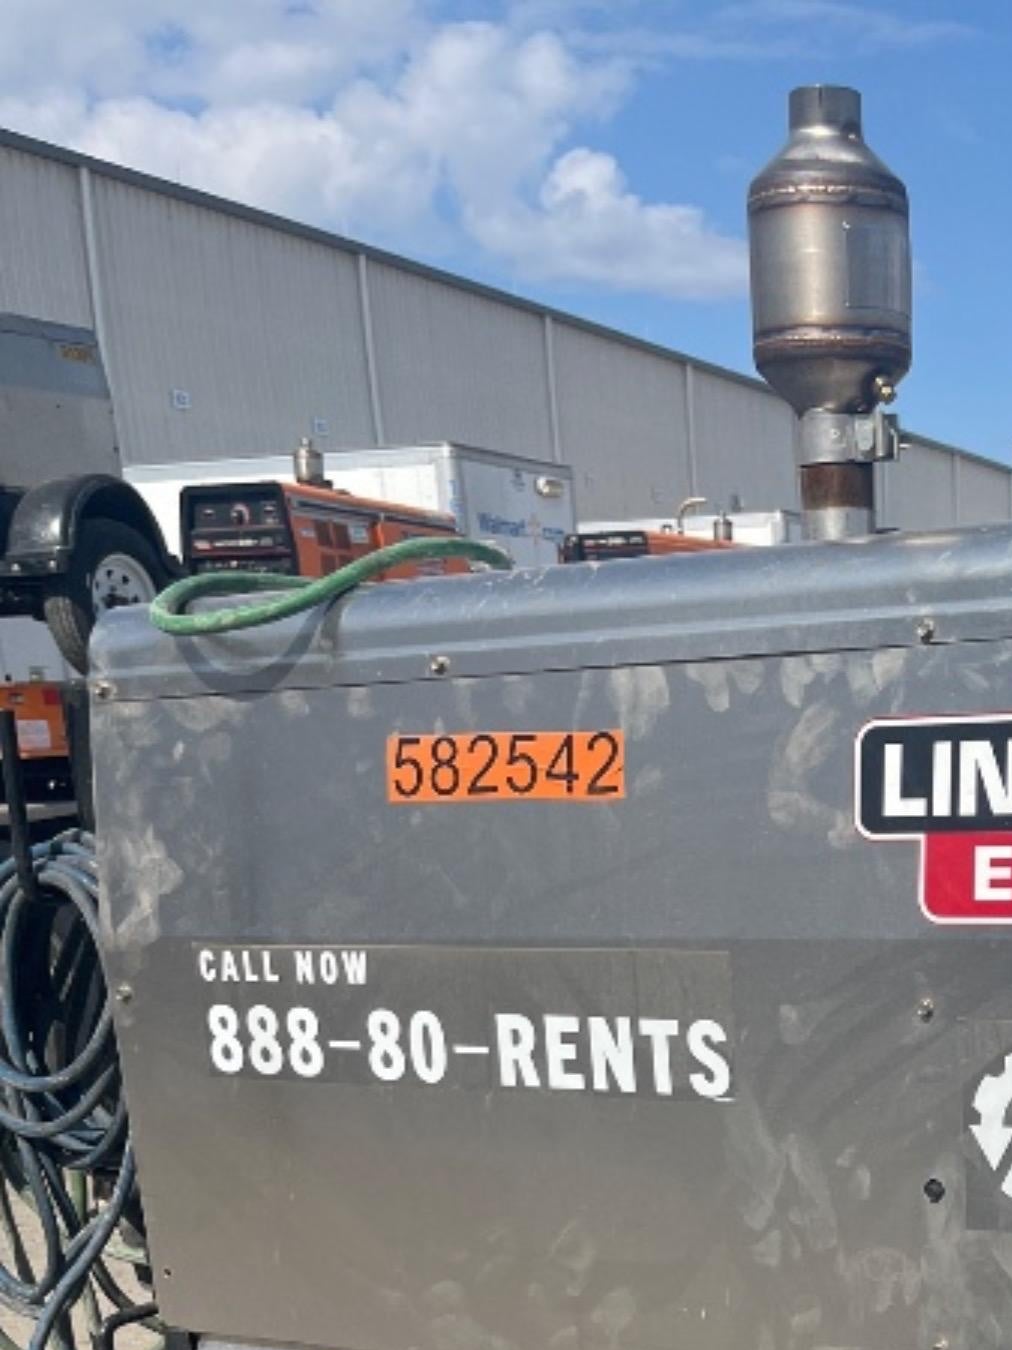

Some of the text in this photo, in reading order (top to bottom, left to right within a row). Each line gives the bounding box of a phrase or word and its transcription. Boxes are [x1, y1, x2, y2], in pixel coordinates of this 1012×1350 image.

[394, 732, 620, 796] 582542
[200, 950, 368, 985] CALL NOW
[207, 1003, 731, 1099] 888-80-RENTS
